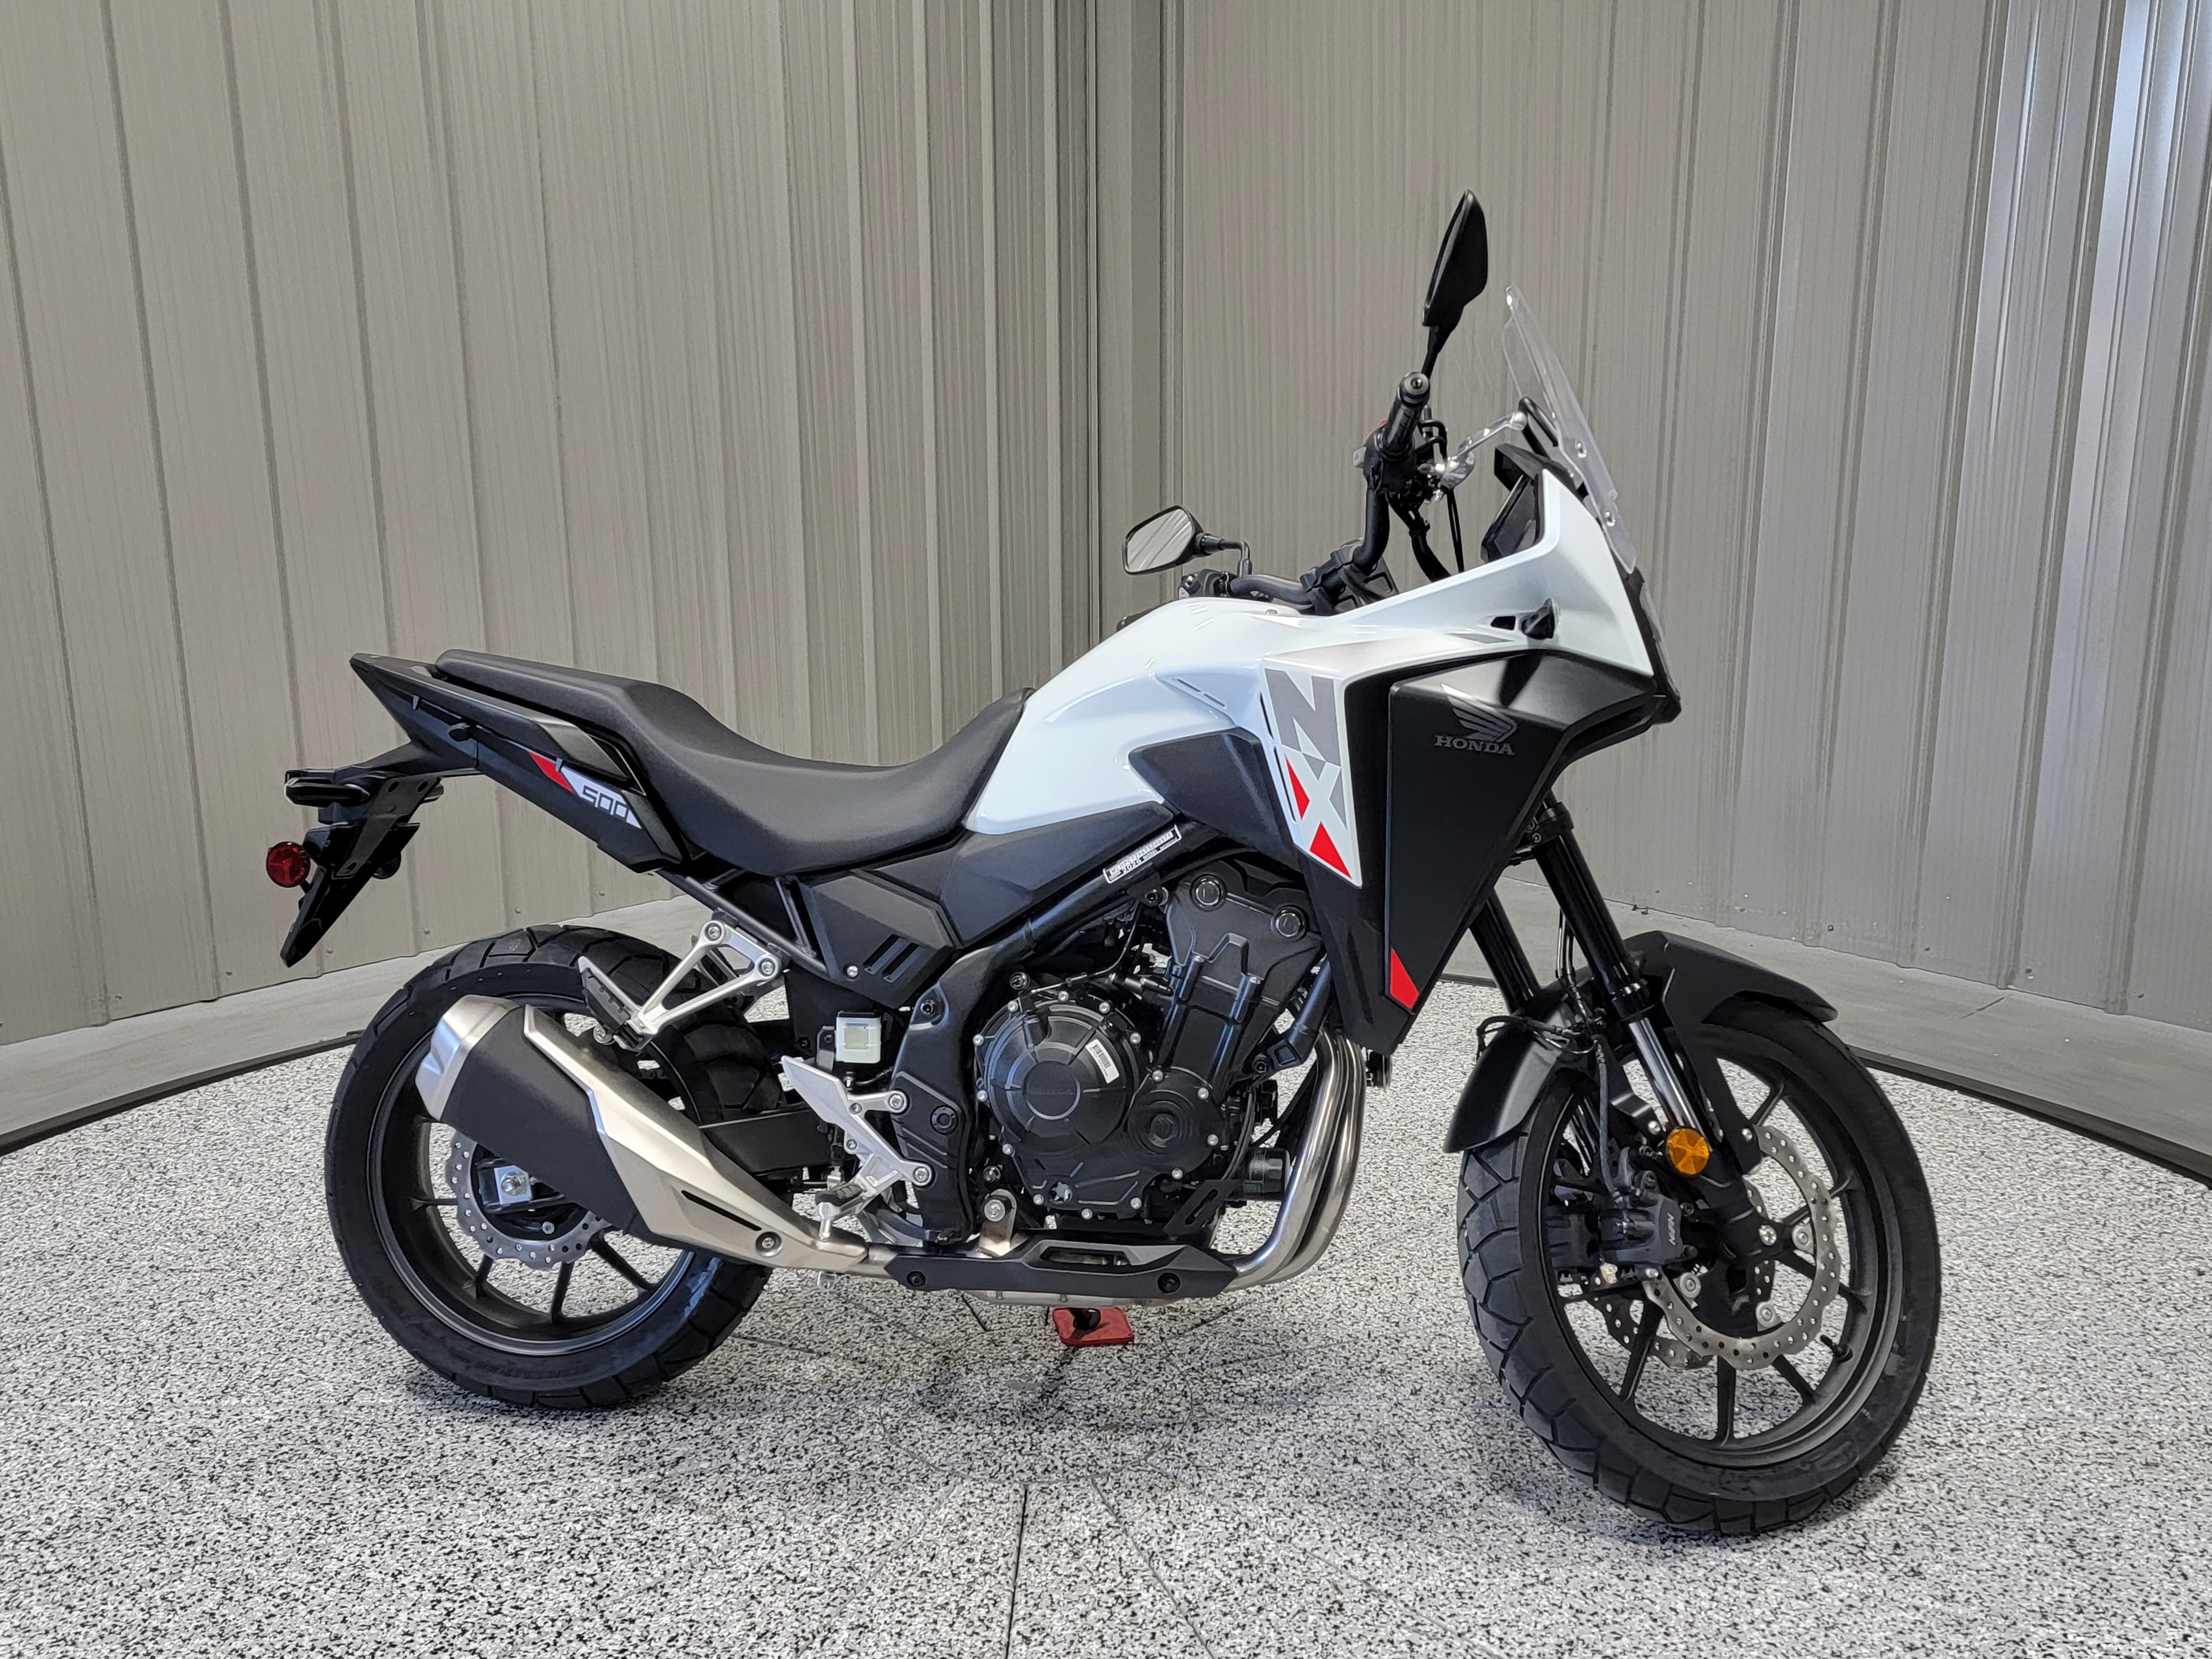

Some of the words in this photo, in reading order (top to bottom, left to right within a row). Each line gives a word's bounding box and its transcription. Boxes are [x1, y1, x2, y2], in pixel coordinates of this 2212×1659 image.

[1433, 734, 1516, 756] HONDA
[1265, 669, 1352, 879] NX
[582, 785, 629, 822] 500
